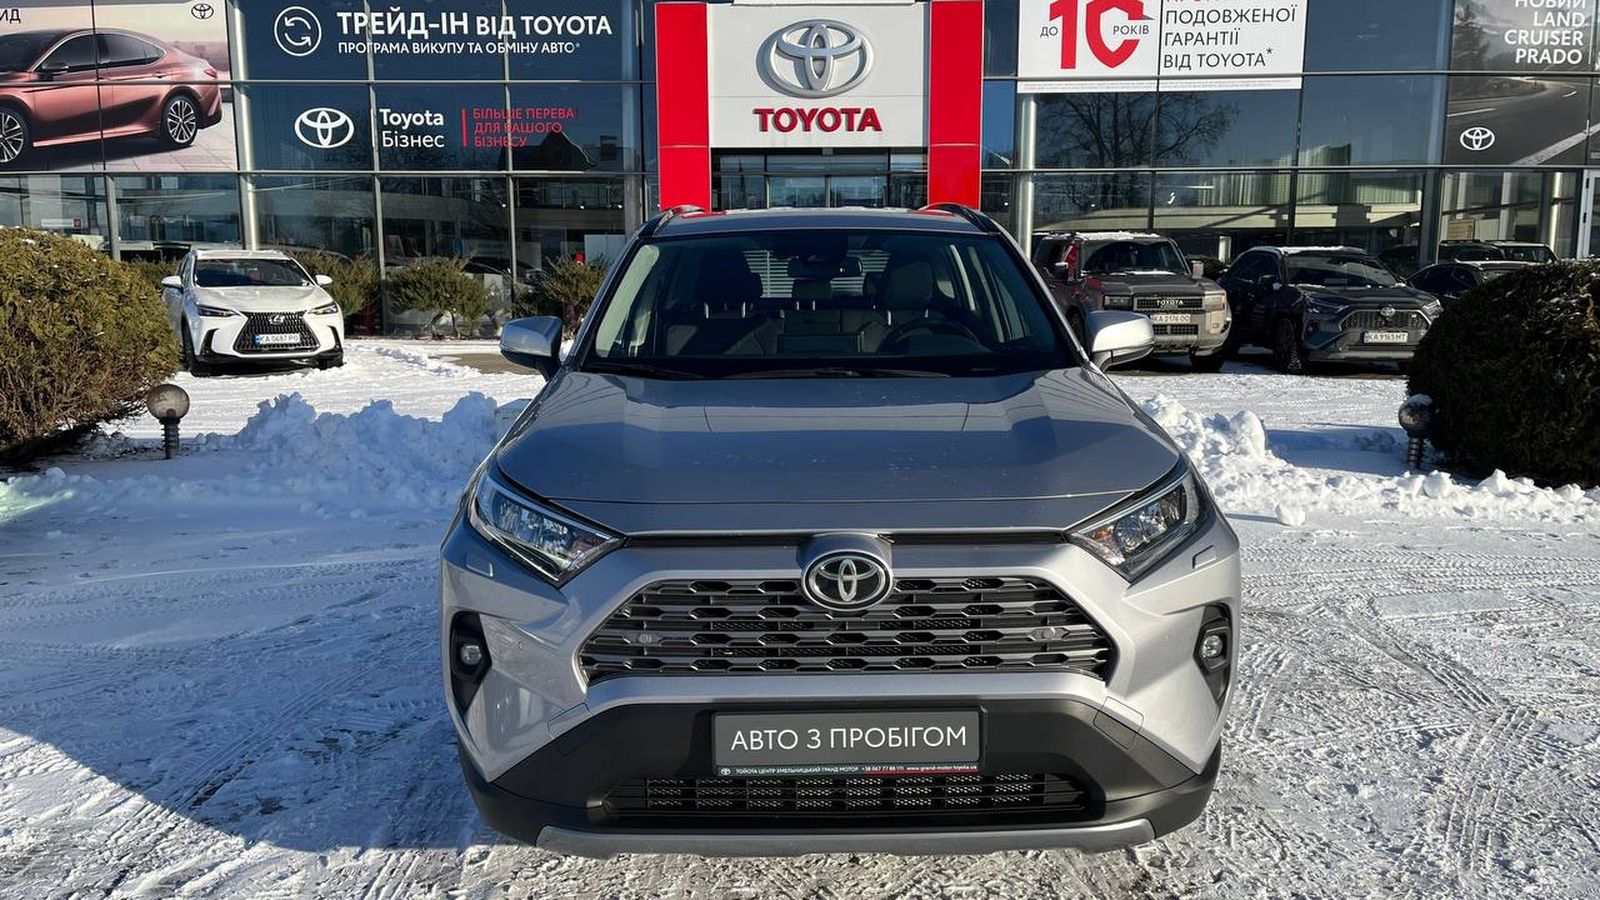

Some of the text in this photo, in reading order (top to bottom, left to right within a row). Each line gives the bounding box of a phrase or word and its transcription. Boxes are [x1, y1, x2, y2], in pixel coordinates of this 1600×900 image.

[336, 6, 612, 40] ТРЕЙД-ІН ВІД TOYOTA
[1165, 4, 1298, 27] ПОДОВЖЕНОЇ
[1533, 12, 1585, 27] LAND
[1040, 26, 1059, 38] ДО
[1113, 24, 1150, 35] РОКІВ
[1164, 27, 1240, 46] ГАРАНТІЇ
[1504, 30, 1584, 46] CRUISER
[338, 42, 410, 54] ПРОГРАМА
[412, 42, 465, 54] ВИКУПУ
[467, 42, 483, 54] ТА
[485, 42, 539, 54] ОБМІНУ
[1515, 48, 1583, 64] PRADO
[1163, 54, 1192, 71] ВІД
[379, 108, 444, 130] Toyota
[753, 107, 882, 132] TOYOTA
[474, 122, 500, 135] ДЛЯ
[382, 130, 445, 148] Бізнес
[731, 730, 799, 750] АВТО
[830, 725, 967, 749] ПРОБІГОМ
